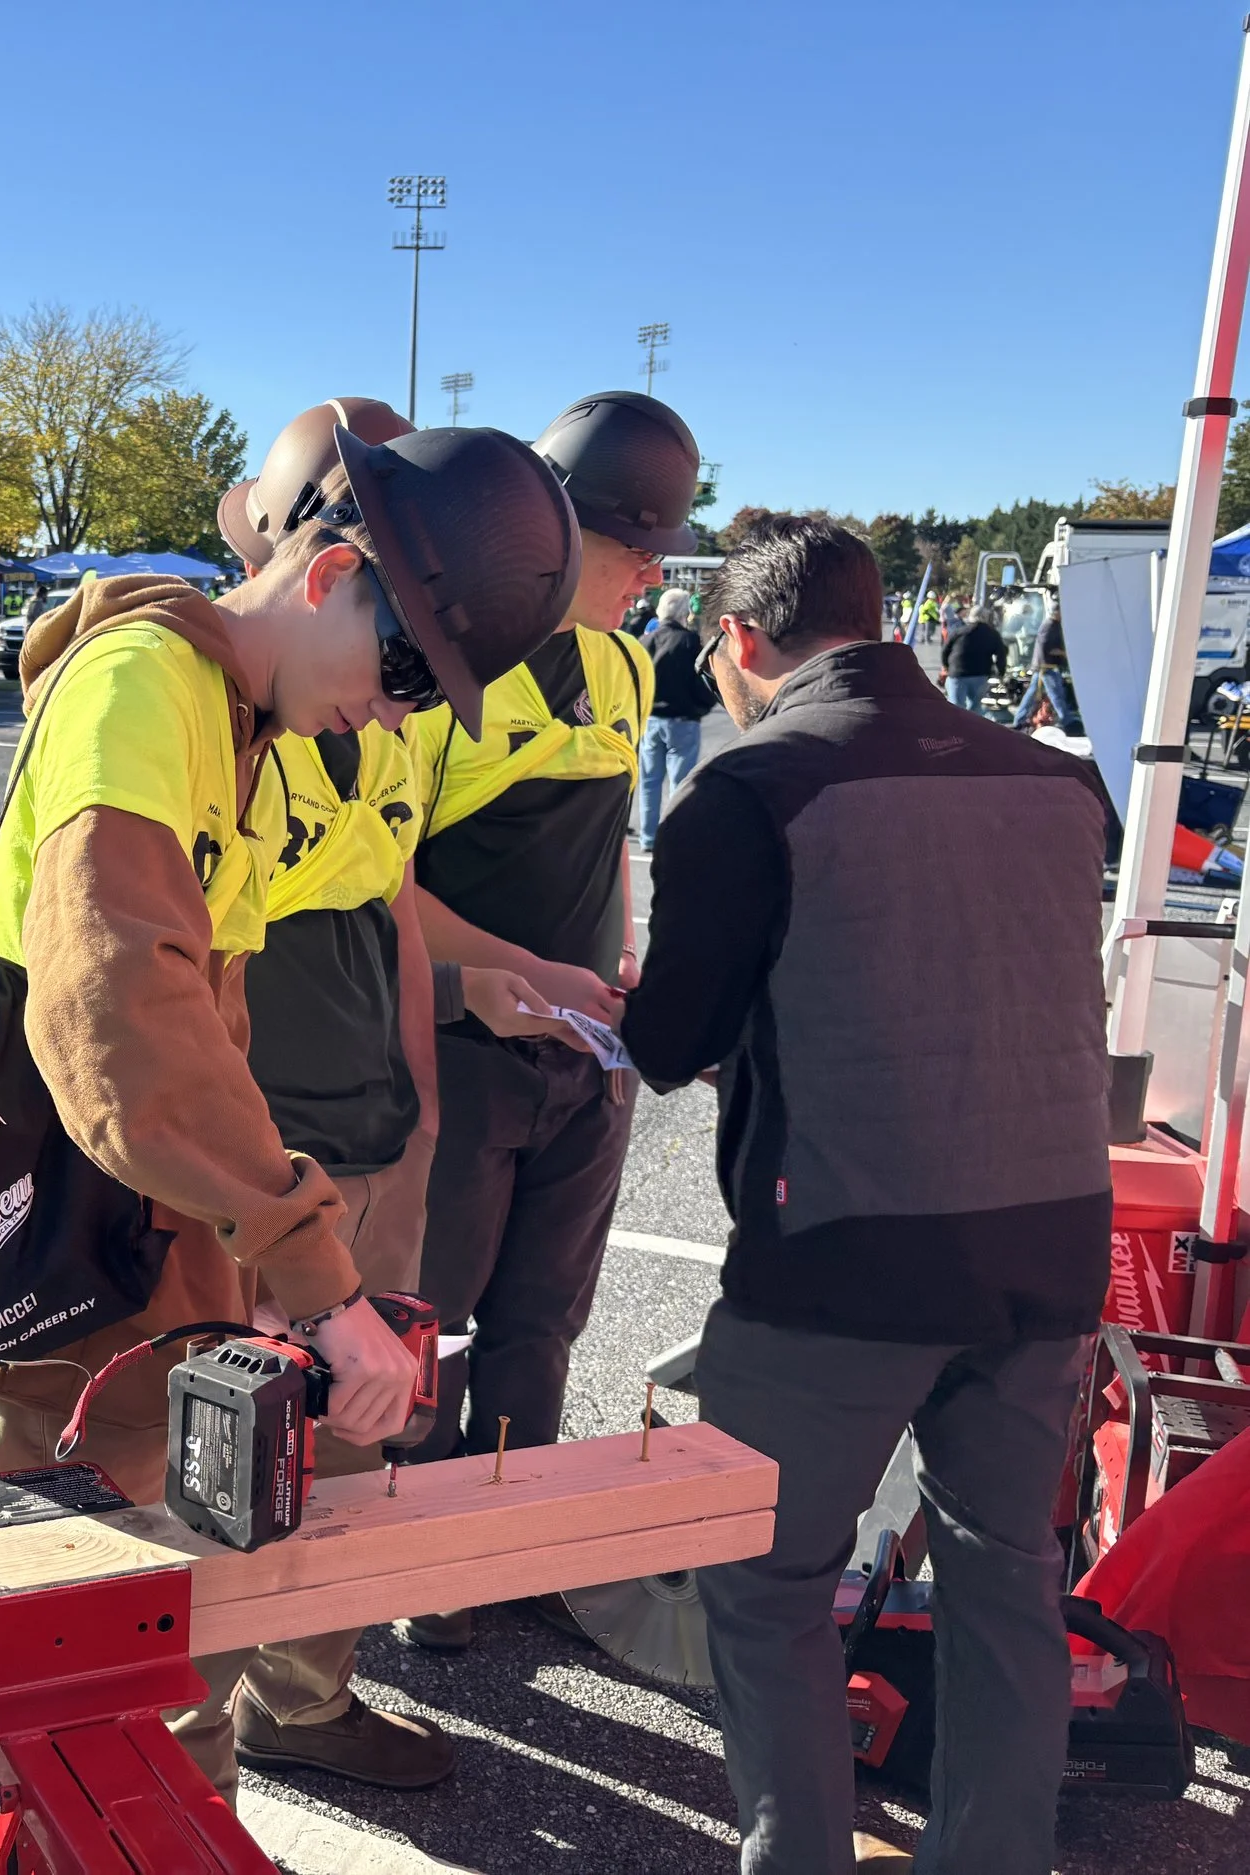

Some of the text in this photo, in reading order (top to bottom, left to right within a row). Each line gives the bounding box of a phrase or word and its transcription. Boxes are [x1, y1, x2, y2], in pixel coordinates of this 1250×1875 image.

[290, 792, 321, 810] RYLAND
[389, 777, 408, 795] DAY
[1172, 1236, 1190, 1272] MX
[19, 1311, 69, 1342] CAREER
[69, 1298, 96, 1317] DAY
[274, 1458, 286, 1523] FORGE
[1063, 1760, 1107, 1771] FORG
